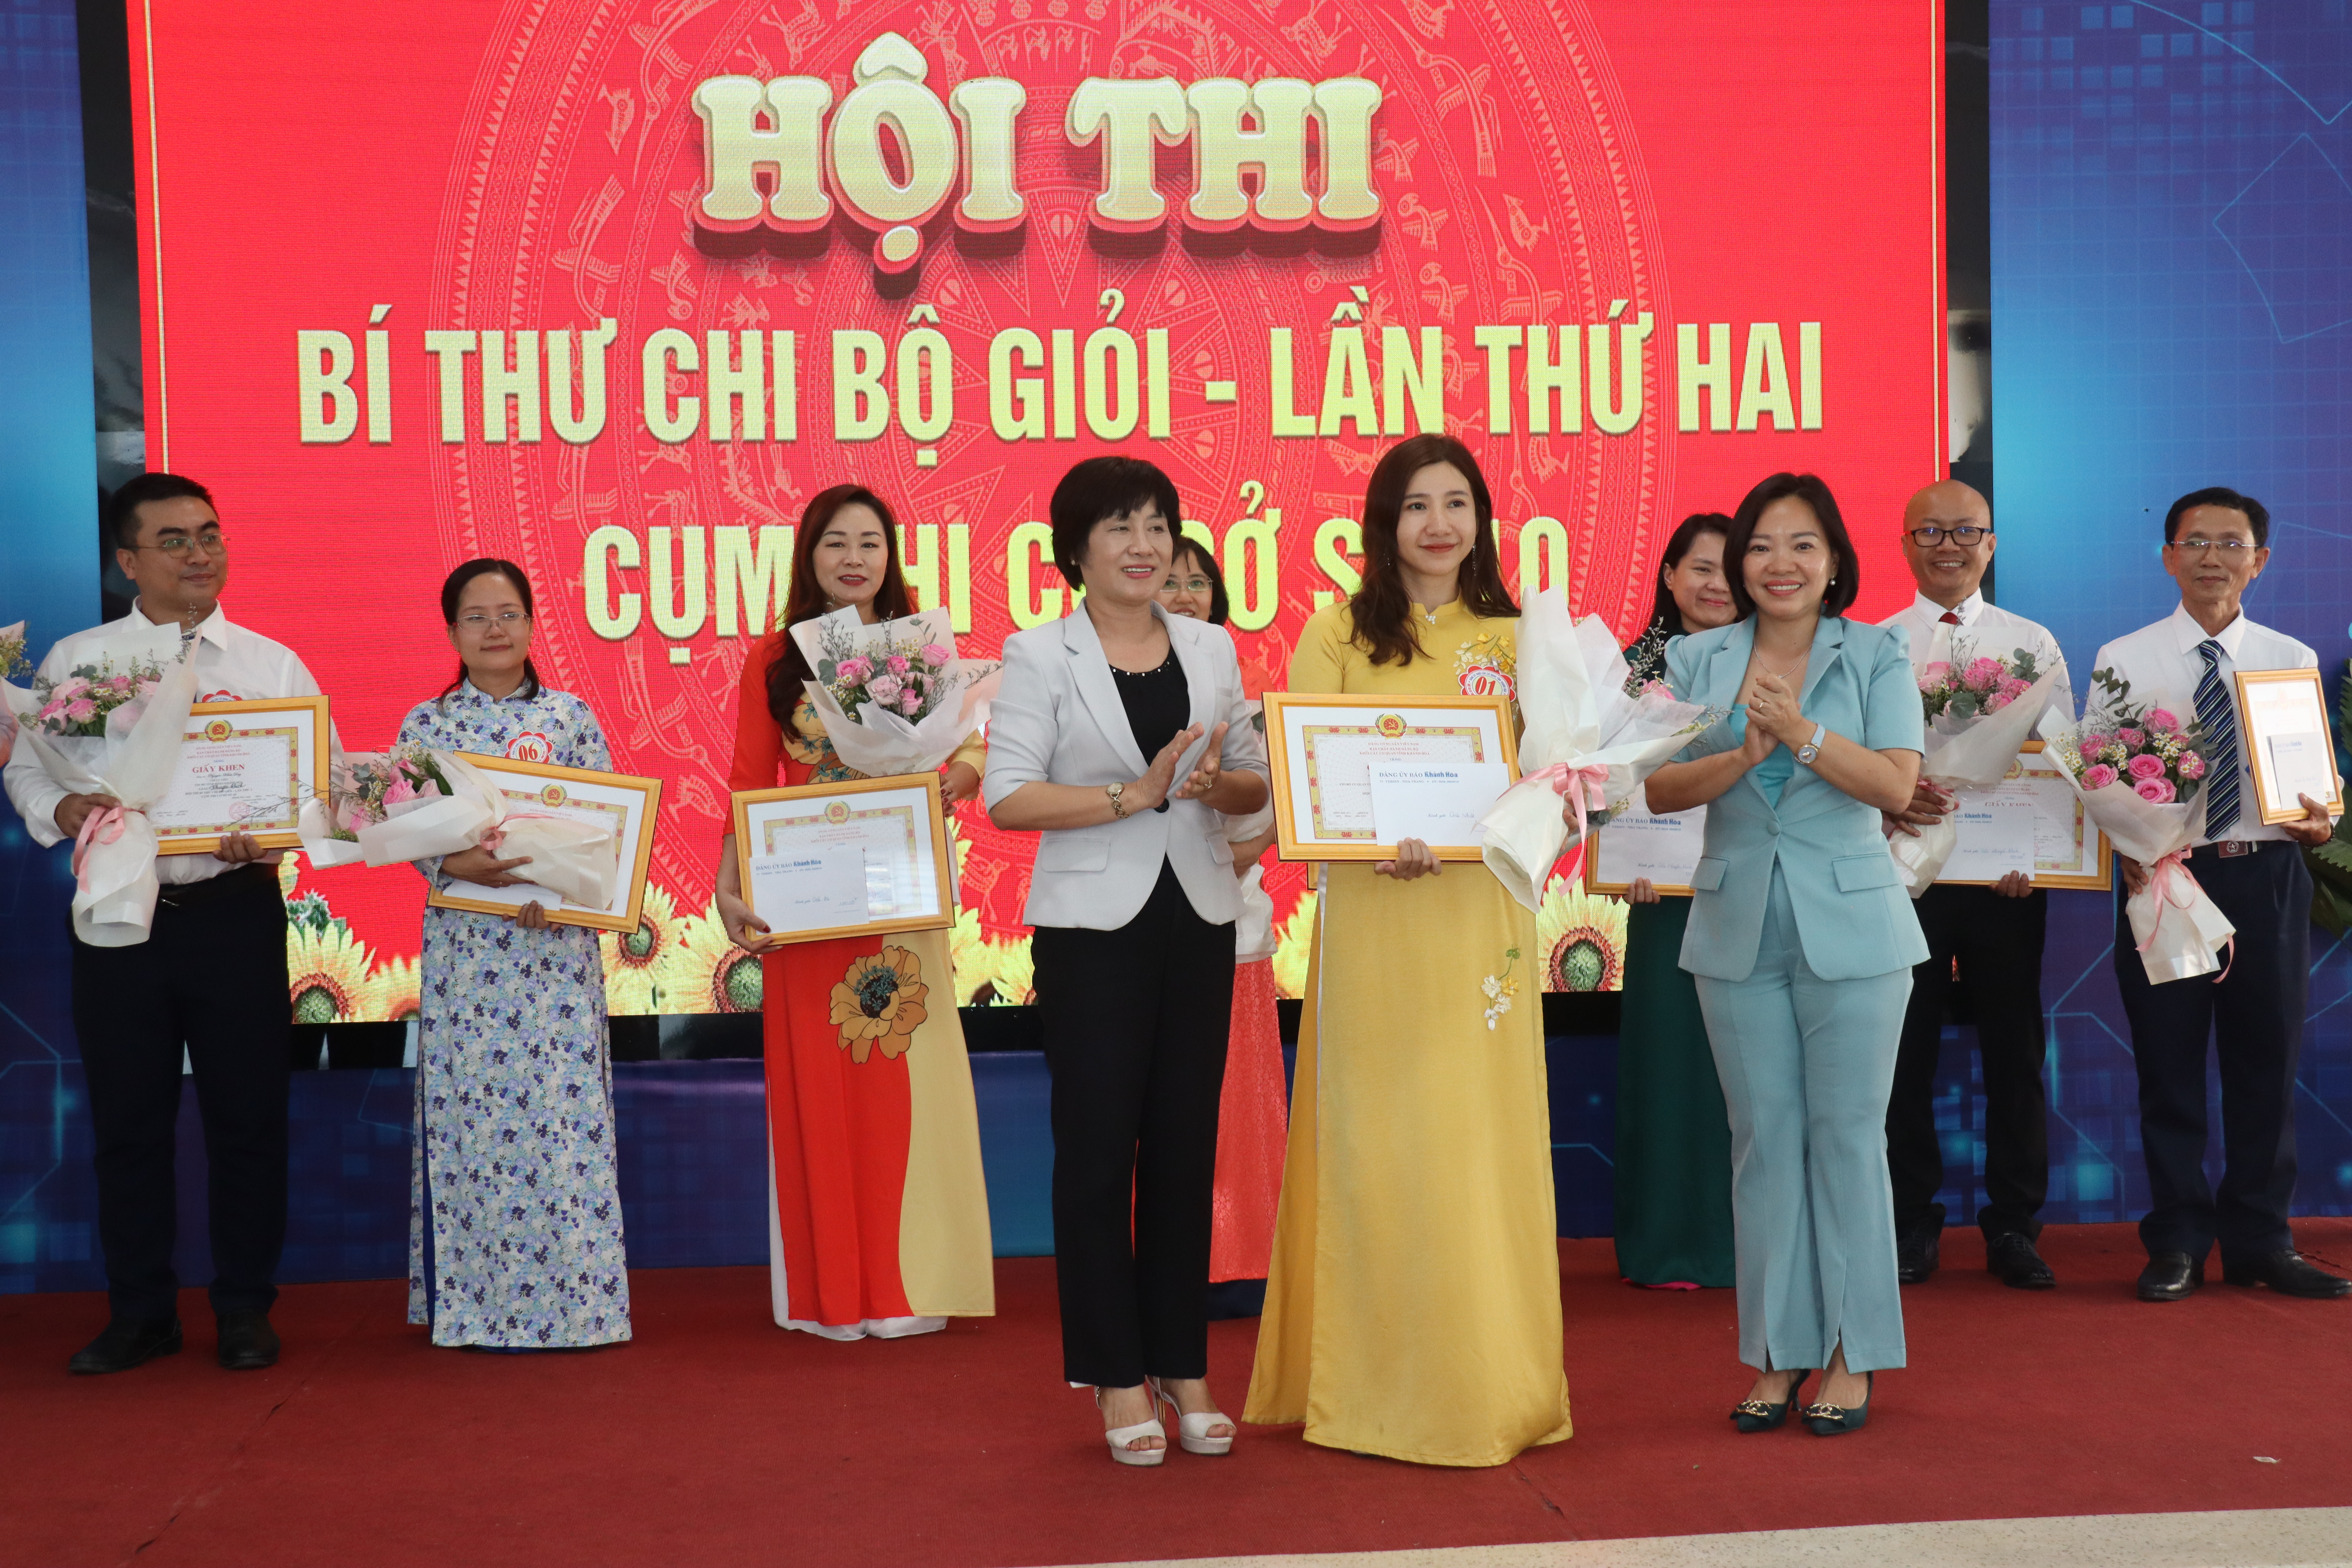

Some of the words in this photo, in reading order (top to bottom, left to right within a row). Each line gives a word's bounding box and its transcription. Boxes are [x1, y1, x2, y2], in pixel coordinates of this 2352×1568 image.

[691, 31, 1027, 270] HỘI
[1065, 74, 1382, 231] THI
[298, 305, 392, 443] BÍ
[425, 318, 618, 444] THƯ
[642, 328, 797, 443] CHI
[832, 304, 953, 466] BỘ
[988, 289, 1171, 440] GIỎI
[1206, 381, 1237, 401] -
[1270, 286, 1444, 436] LẦN
[1474, 299, 1654, 435] THỨ
[1677, 321, 1822, 433] HAI
[583, 524, 794, 665] CỤM
[895, 524, 971, 633] HI
[1181, 481, 1281, 630] Ở
[1475, 676, 1496, 695] 01
[192, 764, 215, 773] GIẤY
[519, 742, 538, 760] 06
